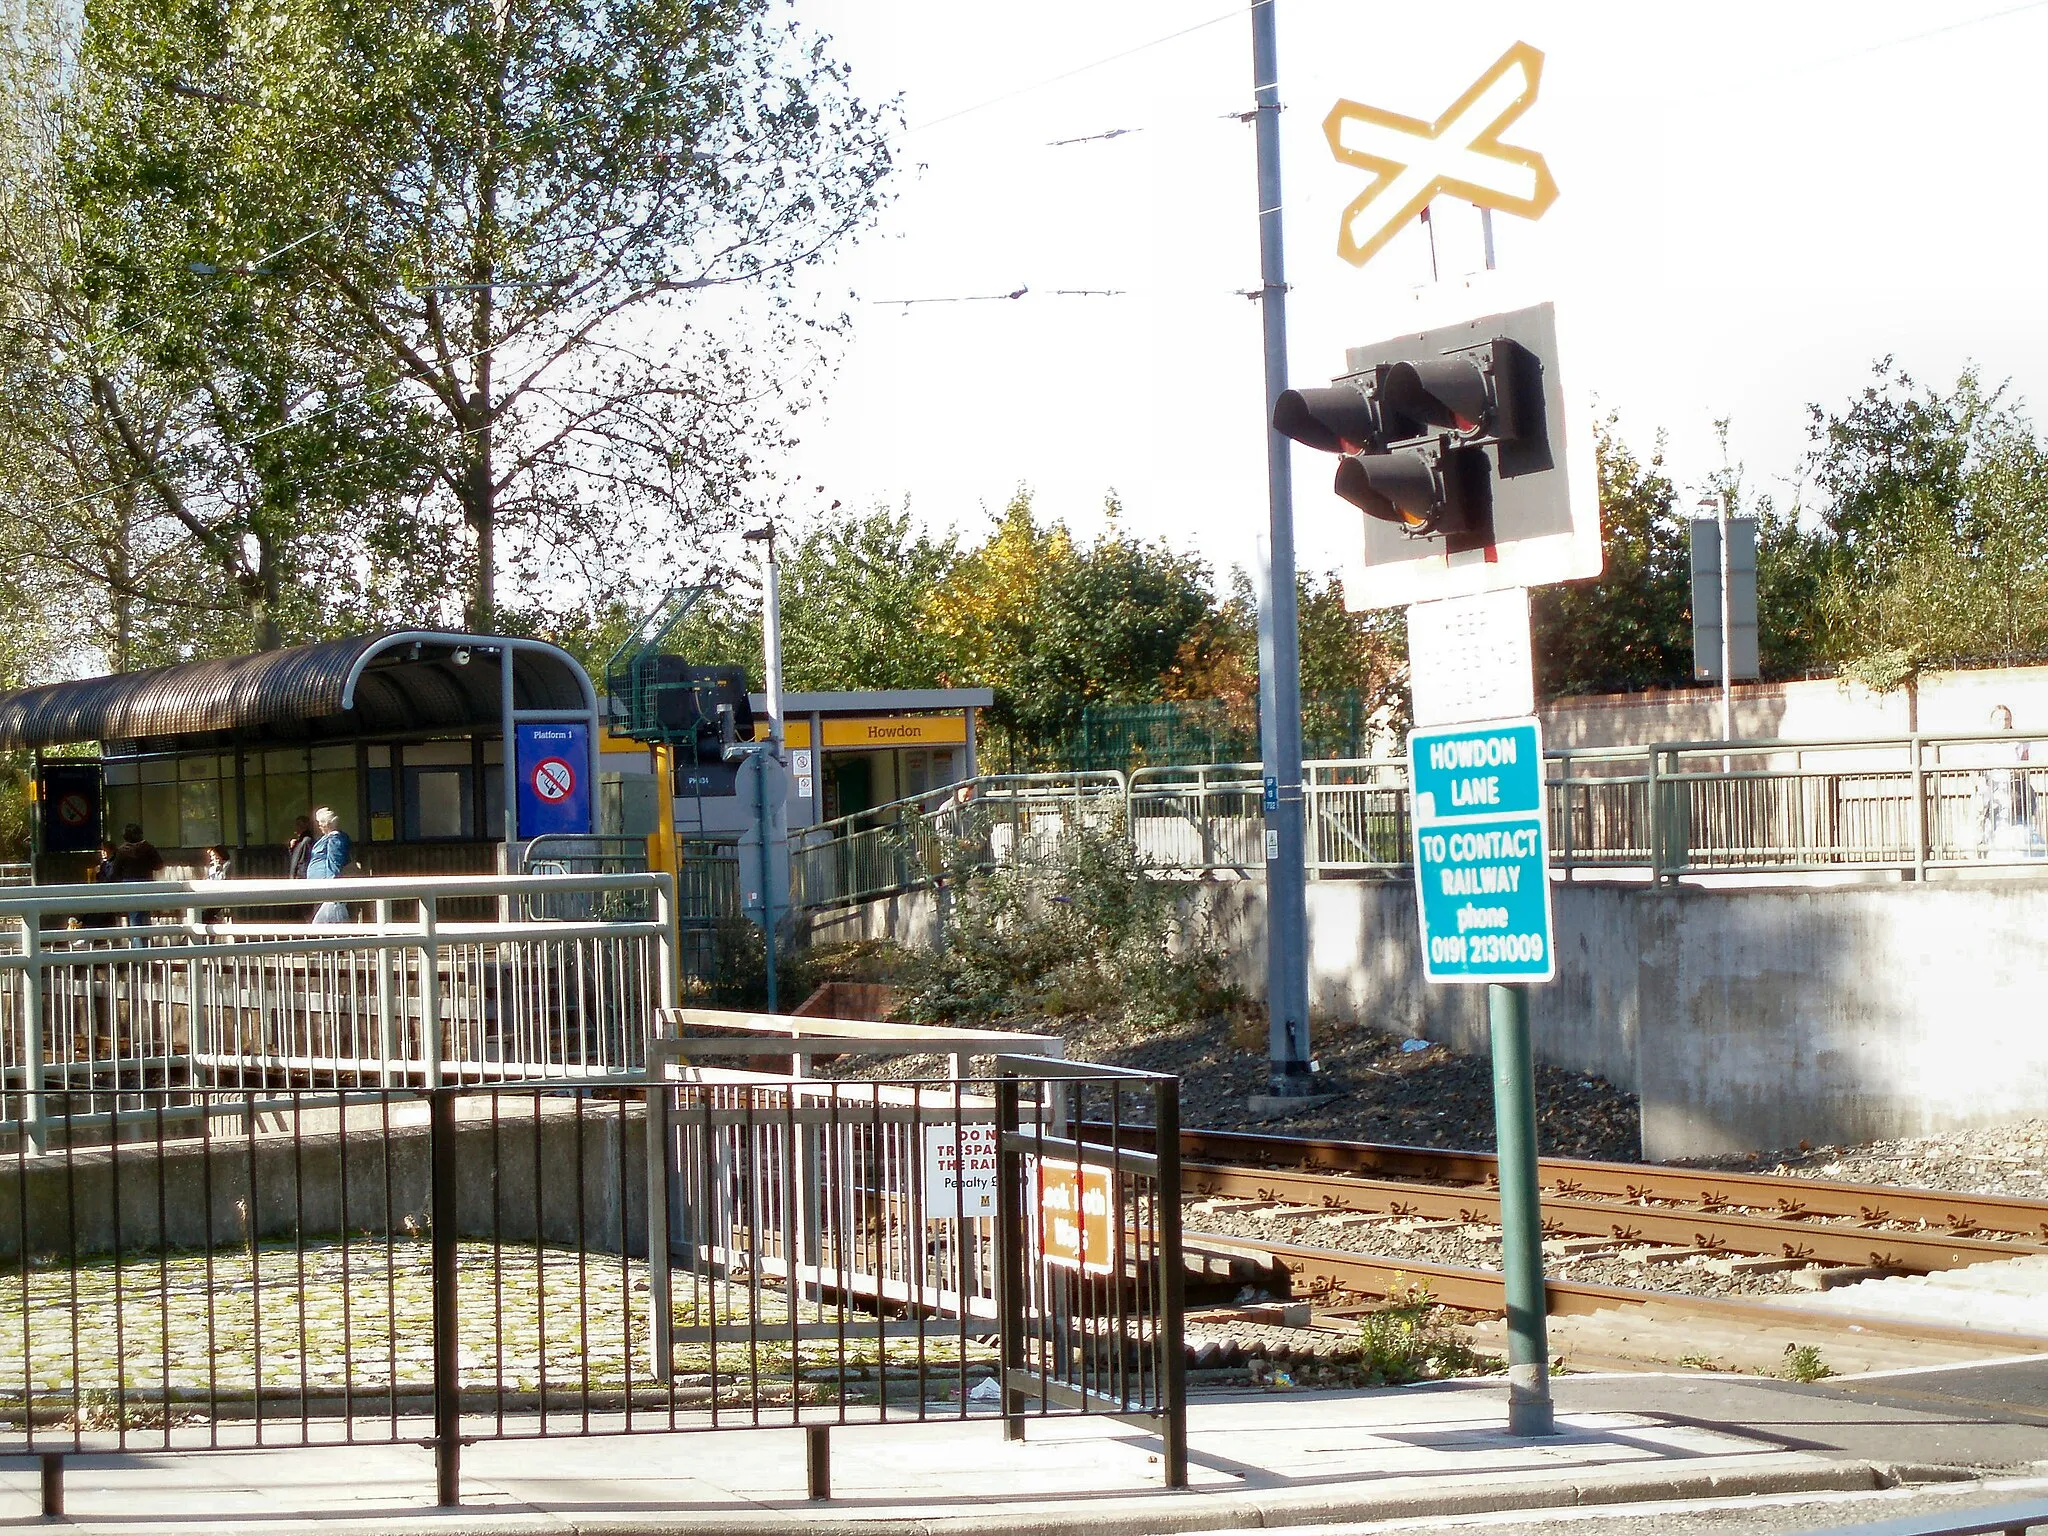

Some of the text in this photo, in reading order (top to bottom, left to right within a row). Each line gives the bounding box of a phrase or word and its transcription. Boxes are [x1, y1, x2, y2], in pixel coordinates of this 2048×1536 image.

[534, 731, 566, 739] Platform
[867, 724, 922, 738] Howdon
[1430, 737, 1517, 770] HOWDON
[1451, 776, 1500, 807] LANE
[1421, 829, 1538, 863] TO CONTACT
[1441, 865, 1520, 896] RAILWAY
[1456, 902, 1508, 934] phone
[1431, 935, 1467, 964] 0191
[945, 1176, 988, 1190] Penalty
